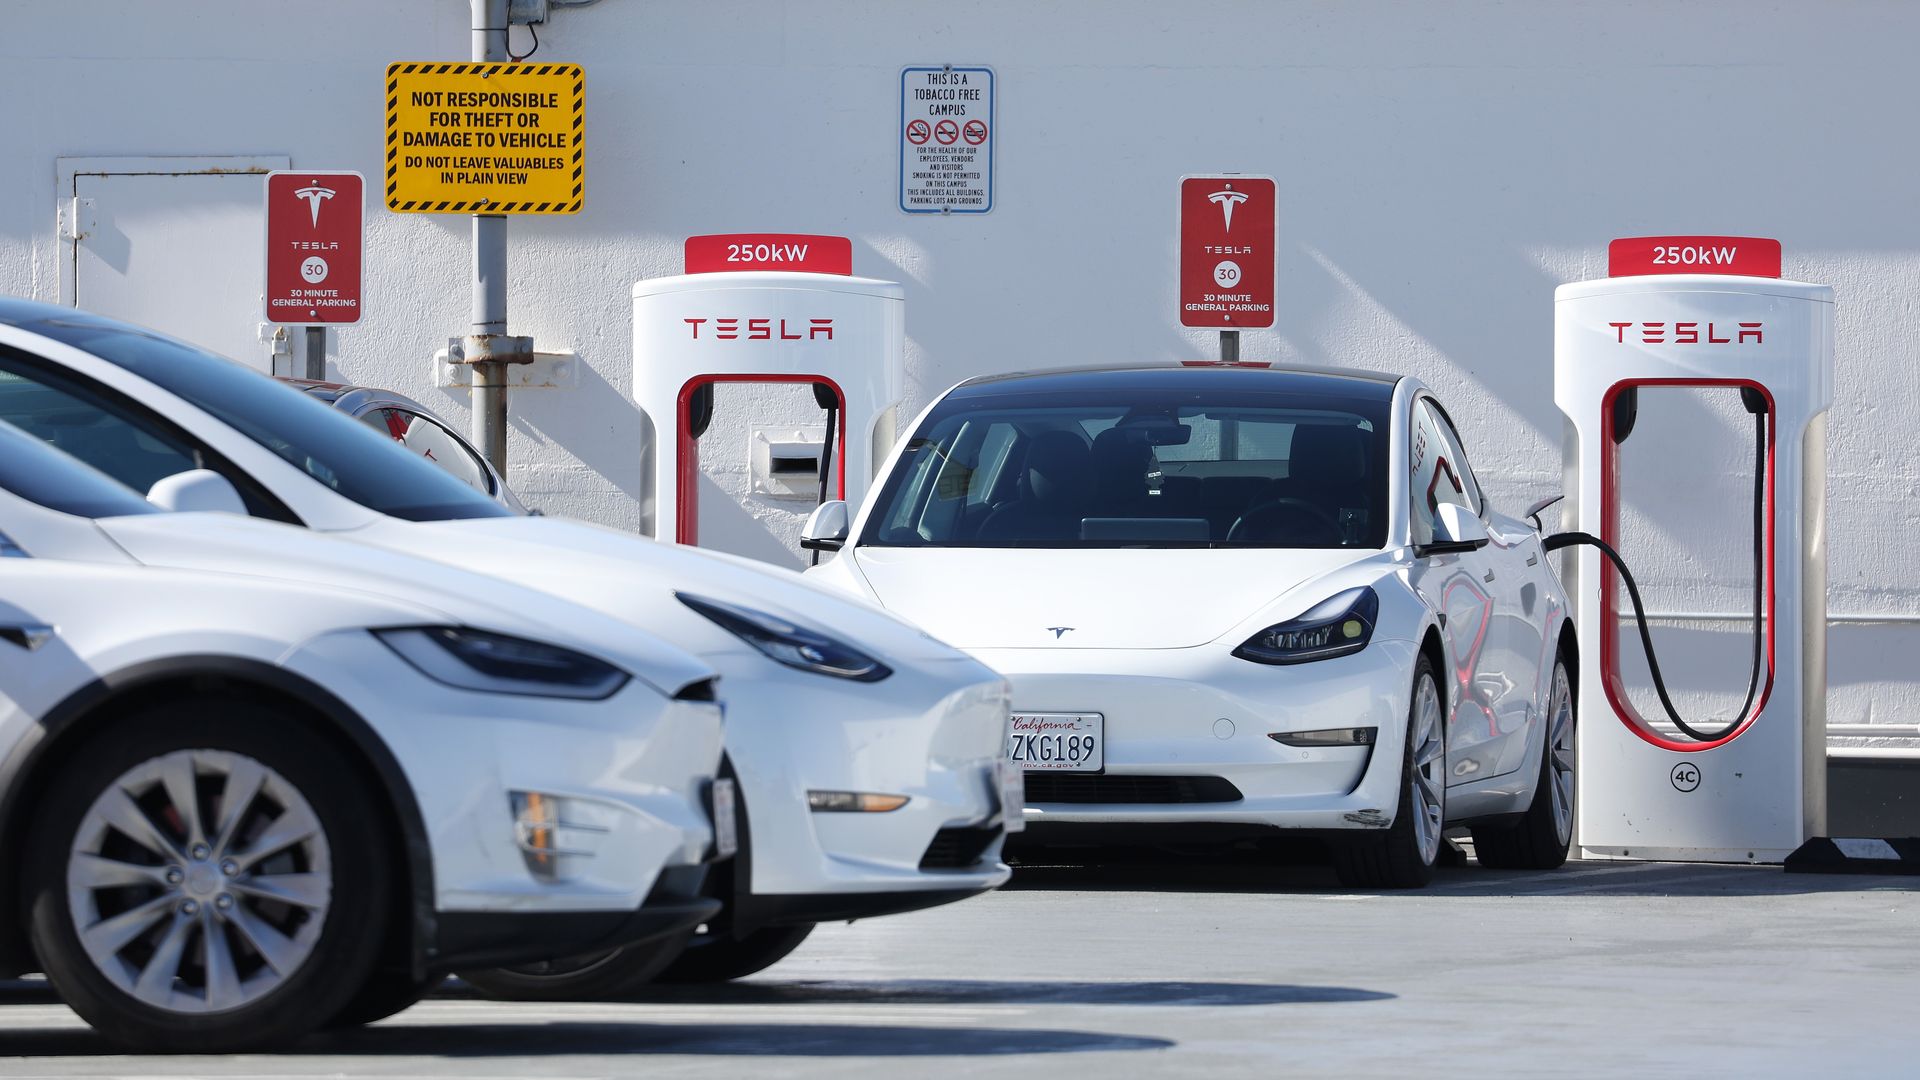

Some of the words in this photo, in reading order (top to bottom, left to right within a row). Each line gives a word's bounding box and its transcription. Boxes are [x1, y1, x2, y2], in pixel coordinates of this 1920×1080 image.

[928, 74, 947, 84] THIS
[951, 74, 958, 84] IS
[962, 74, 967, 84] A
[412, 92, 443, 107] NOT
[448, 92, 558, 108] RESPONSIBLE
[915, 89, 955, 100] TOBACCO
[959, 89, 980, 100] FREE
[929, 105, 965, 115] CAMPUS
[430, 112, 461, 127] FOR
[465, 113, 513, 127] THEFT
[517, 113, 539, 127] OR
[403, 132, 472, 147] DAMAGE
[475, 132, 495, 147] TO
[499, 133, 566, 148] VEHICLE
[405, 156, 422, 168] DO
[426, 157, 450, 168] NOT
[453, 157, 491, 168] LEAVE
[494, 157, 564, 169] VALUABLES
[441, 172, 454, 183] IN
[457, 173, 494, 184] PLAIN
[497, 173, 528, 184] VIEW
[727, 244, 808, 262] 250kW
[1205, 246, 1251, 254] TESLA
[1653, 246, 1736, 264] 250kW
[306, 265, 323, 275] 30
[1219, 269, 1236, 279] 30
[684, 319, 832, 339] TESLA
[1609, 322, 1762, 343] TESLA
[1014, 717, 1081, 734] California
[1007, 735, 1094, 761] ZKG189
[1675, 771, 1695, 782] 4C
